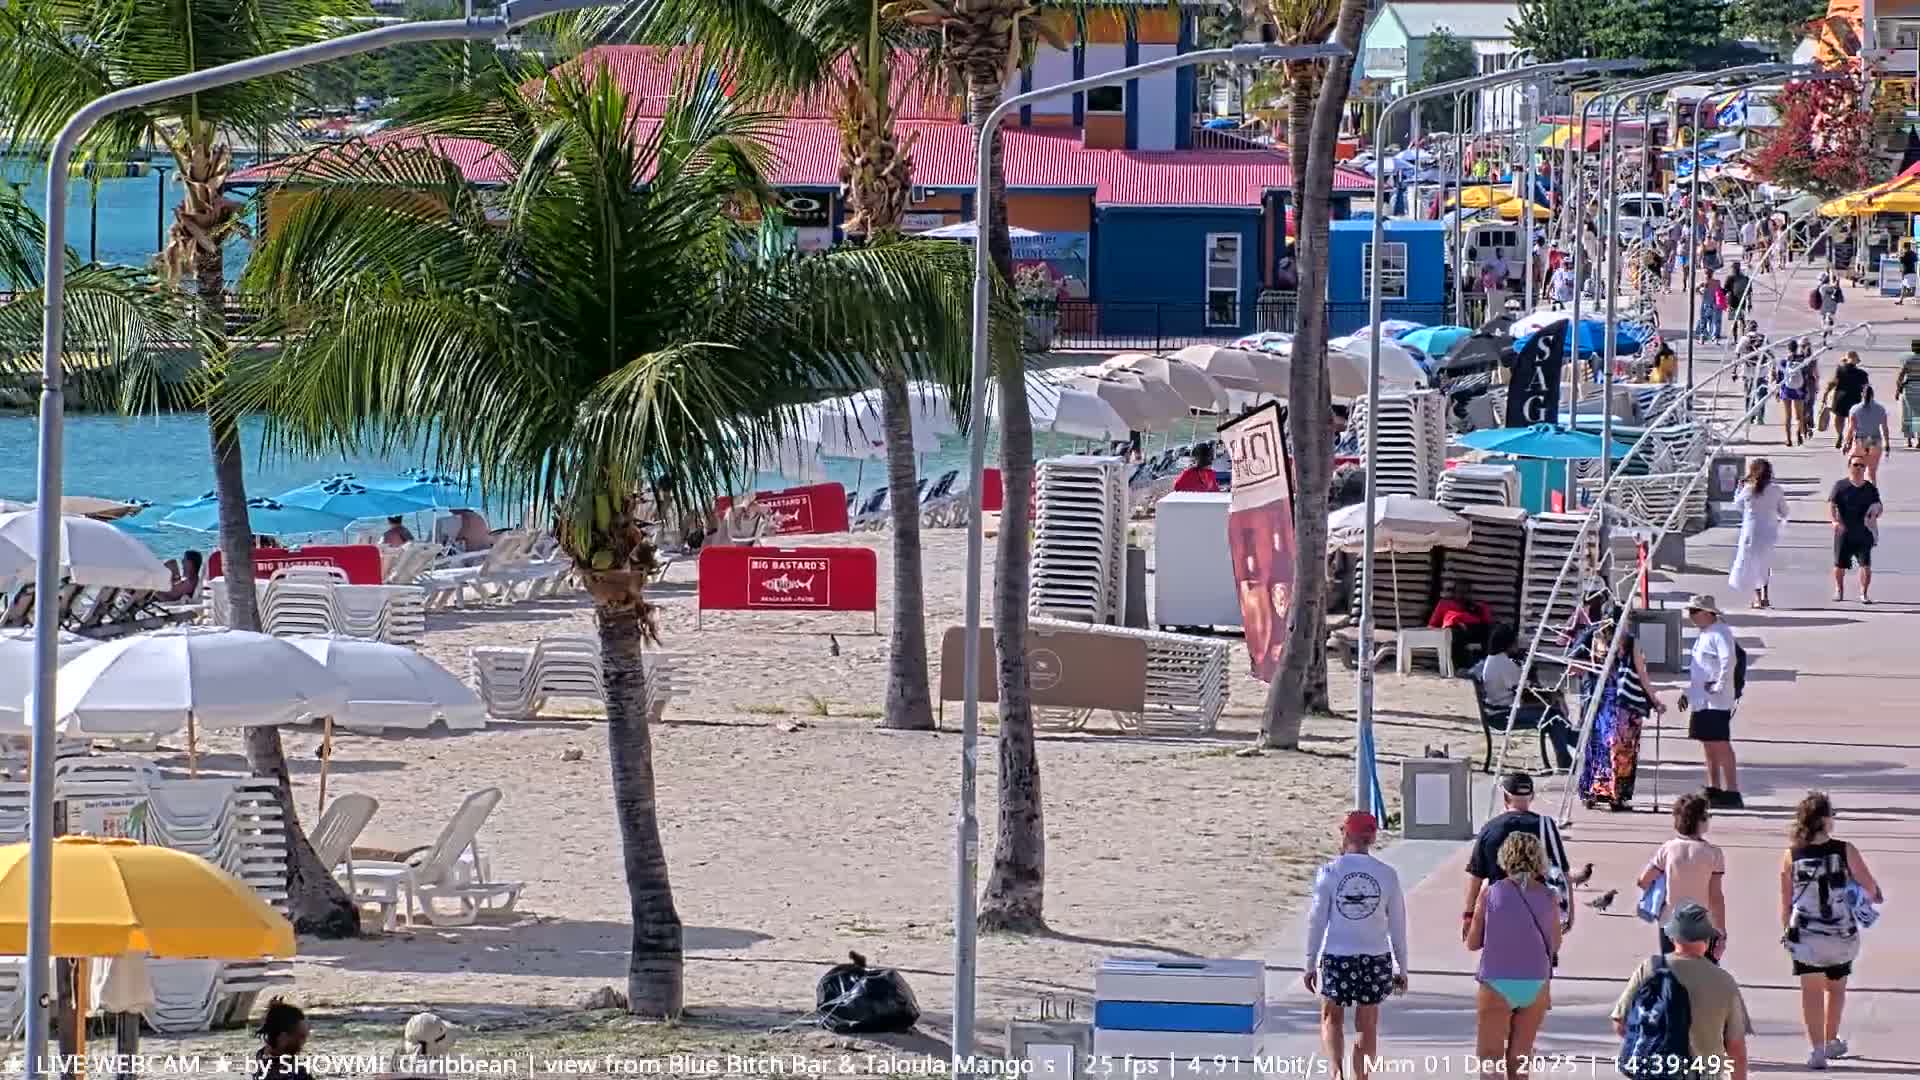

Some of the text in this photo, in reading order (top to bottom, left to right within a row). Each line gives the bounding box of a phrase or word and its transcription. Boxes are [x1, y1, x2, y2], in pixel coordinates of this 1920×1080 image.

[257, 562, 274, 571] BIG
[751, 560, 826, 570] BIG BASTARD'S
